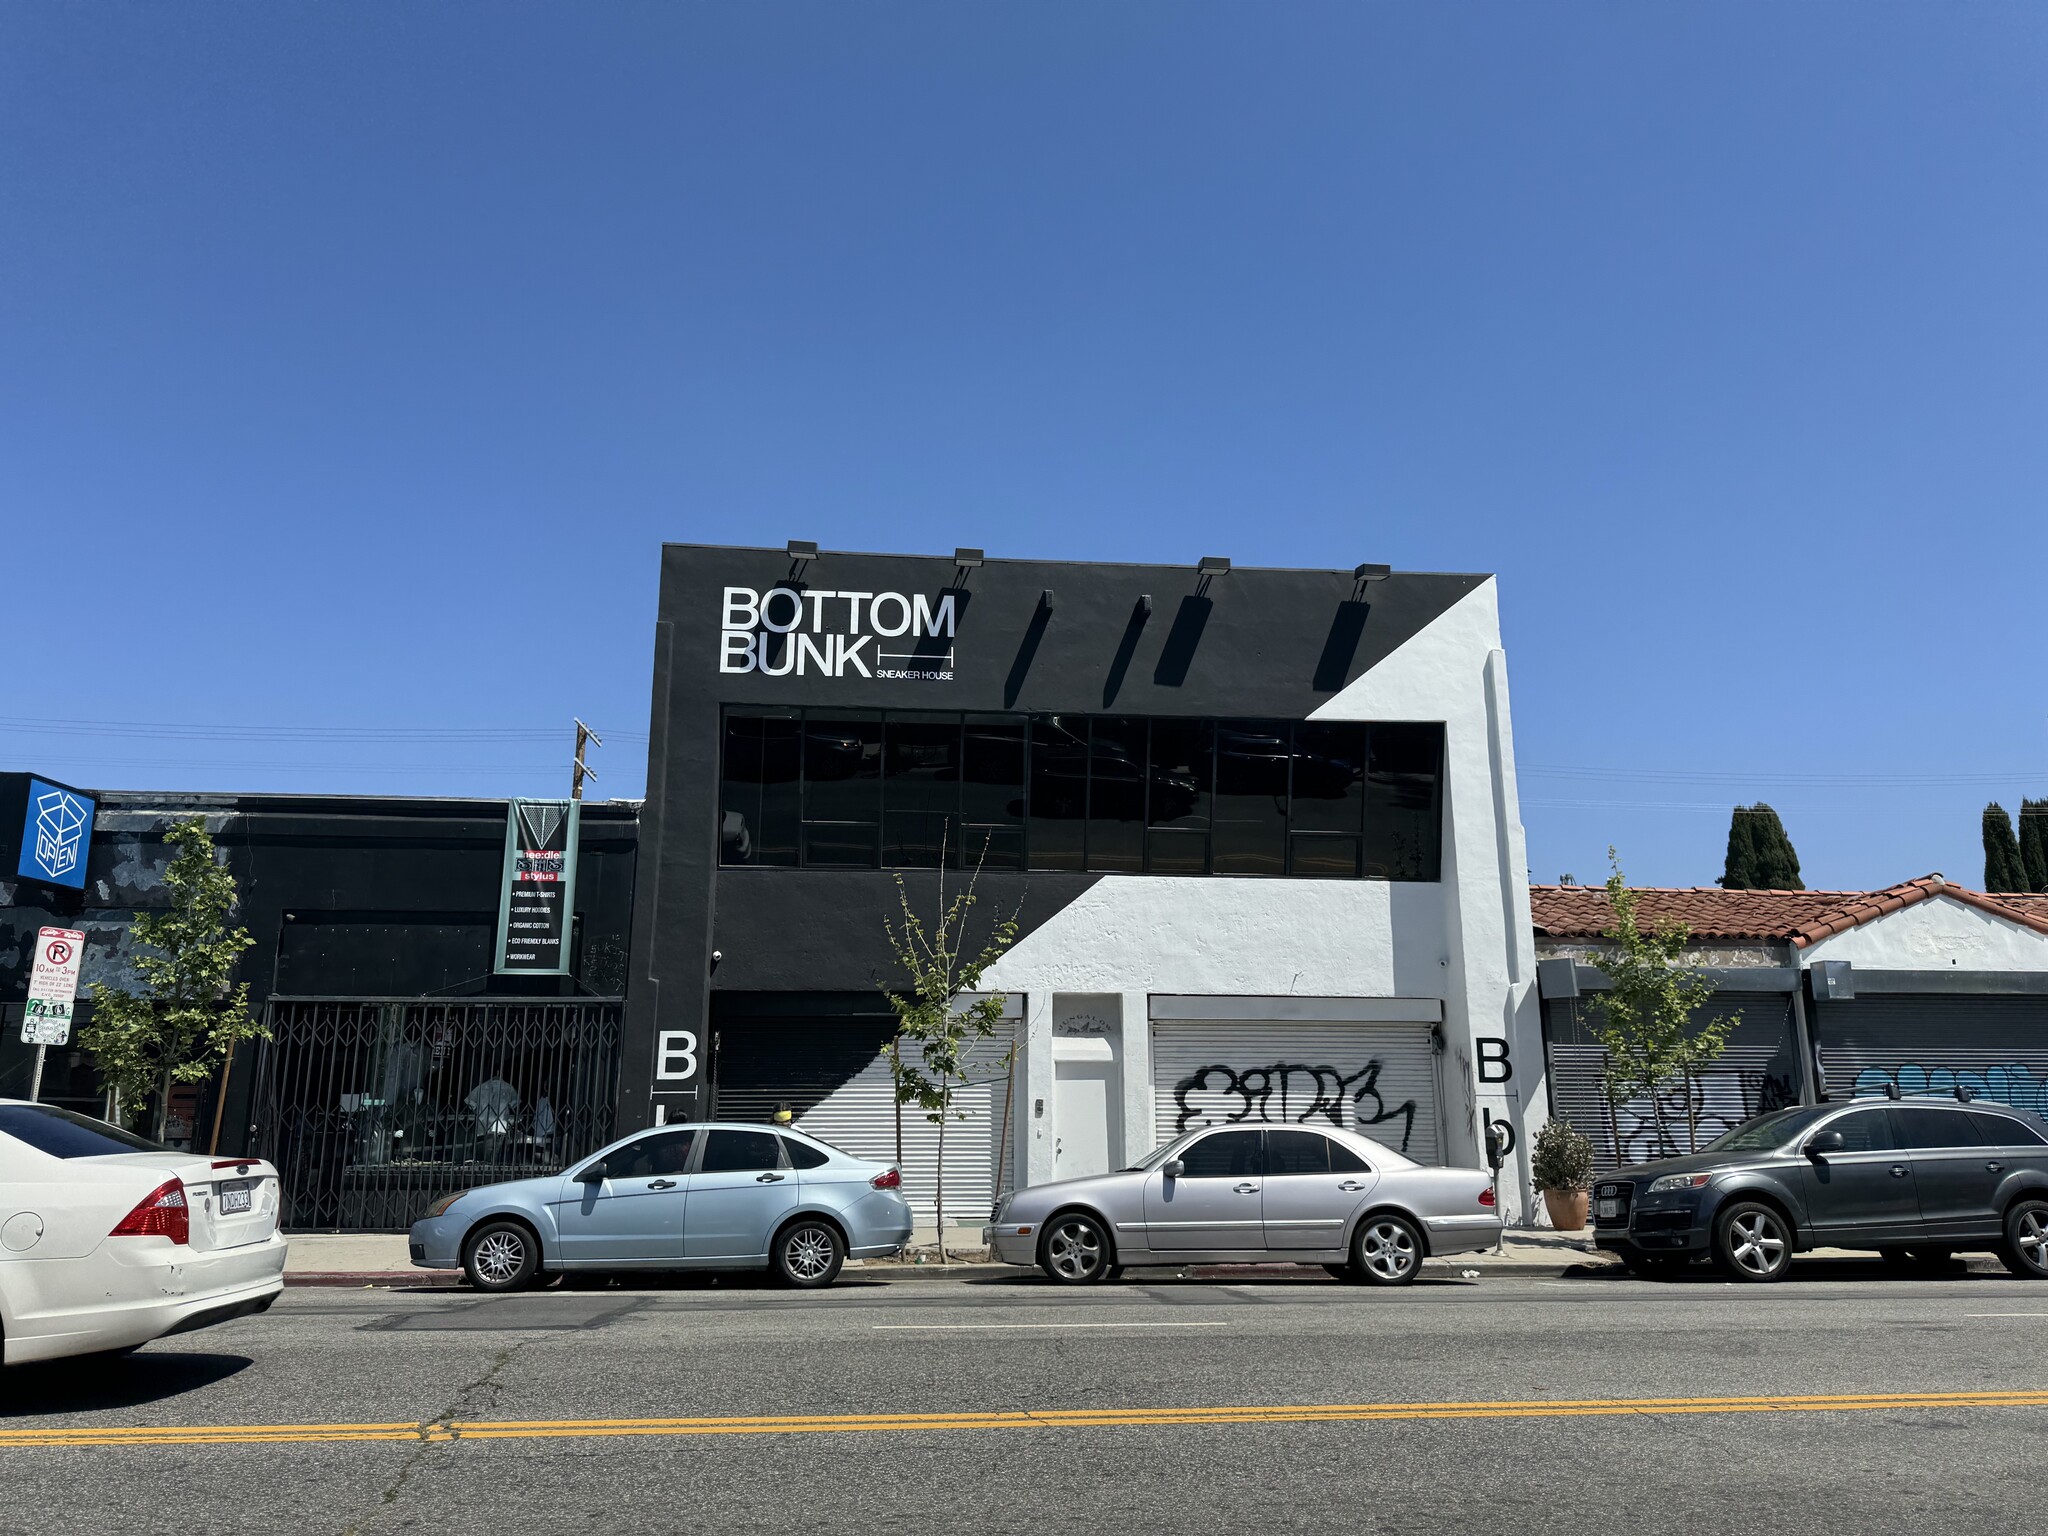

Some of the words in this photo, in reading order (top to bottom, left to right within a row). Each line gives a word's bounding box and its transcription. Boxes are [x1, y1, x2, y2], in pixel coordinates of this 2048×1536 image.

[722, 586, 956, 638] BOTTOM
[719, 630, 873, 678] BUNK
[876, 669, 921, 680] SNEAKER
[921, 671, 954, 681] HOUSE
[39, 834, 76, 868] OPEN
[515, 890, 536, 898] PREMIUM
[524, 871, 555, 880] stylus
[656, 1030, 697, 1080] B
[1476, 1037, 1513, 1083] B
